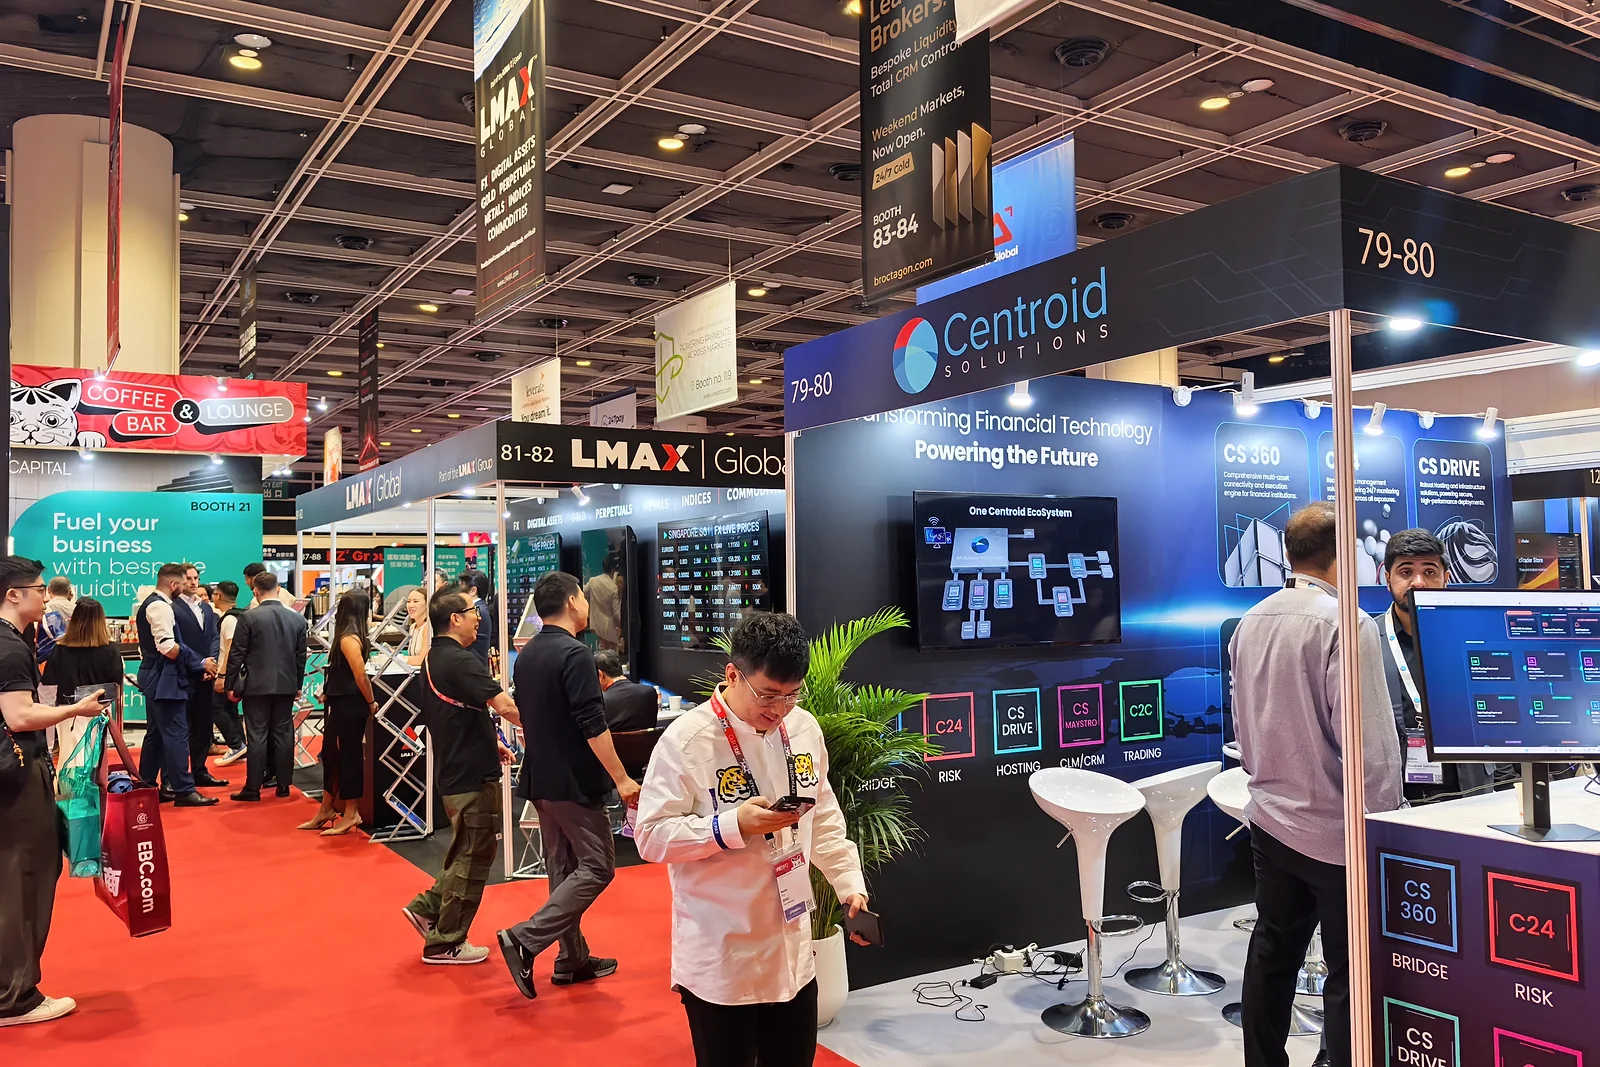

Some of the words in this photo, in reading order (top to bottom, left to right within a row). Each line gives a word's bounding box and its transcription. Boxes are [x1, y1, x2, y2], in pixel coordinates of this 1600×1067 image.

[870, 0, 947, 53] Brokers.
[870, 47, 912, 79] Bespoke
[914, 19, 957, 54] Liquidity
[870, 74, 893, 98] Total
[895, 60, 919, 83] CRM
[481, 55, 535, 145] LMAX
[871, 107, 918, 142] Weekend
[920, 85, 965, 117] Markets,
[872, 141, 895, 162] Now
[895, 127, 926, 149] Open.
[491, 155, 513, 183] DIGITAL
[513, 135, 536, 164] ASSETS
[875, 167, 893, 184] 24/7
[893, 157, 910, 176] Gold
[480, 189, 497, 210] GOLD
[499, 156, 536, 196] PERPETUALS
[484, 200, 505, 227] METALS
[508, 178, 533, 208] INDICES
[487, 203, 528, 242] COMMODITIES
[873, 204, 902, 227] BOOTH
[872, 212, 919, 250] 83-84
[1359, 227, 1435, 278] 79-80
[873, 256, 933, 287] broctagon.com
[944, 266, 1108, 356] Centroid
[944, 323, 1109, 378] SOLUTIONS
[695, 375, 713, 390] Booth
[791, 370, 833, 404] 79-80
[87, 385, 167, 409] COFFEE
[179, 404, 194, 420] &
[206, 402, 285, 420] LOUNGE
[530, 408, 546, 421] dream
[126, 416, 167, 432] BAR
[975, 409, 1056, 435] Financial
[1060, 416, 1153, 445] Technology
[501, 444, 554, 463] 81-82
[571, 438, 690, 472] LMAX
[915, 439, 1005, 469] Powering
[1007, 444, 1039, 465] the
[1040, 448, 1099, 467] Future
[1223, 443, 1247, 464] CS
[1250, 444, 1280, 466] 360
[9, 459, 72, 476] CAPITAL
[1223, 471, 1262, 480] Comprehensive
[1418, 456, 1438, 475] CS
[1440, 458, 1481, 477] DRIVE
[346, 477, 373, 511] LMAX
[377, 467, 402, 503] Global
[190, 501, 236, 512] BOOTH
[238, 502, 251, 512] 21
[513, 522, 520, 531] FX
[527, 517, 546, 530] DIGITAL
[546, 515, 563, 528] ASSETS
[595, 504, 633, 519] PERPETUALS
[681, 491, 712, 507] INDICES
[969, 506, 988, 516] One
[988, 506, 1026, 517] Centroid
[1026, 507, 1073, 519] EcoSystem
[53, 512, 102, 531] Fuel
[108, 516, 159, 535] your
[737, 521, 760, 533] PRICES
[53, 535, 153, 554] business
[53, 557, 102, 575] with
[1007, 706, 1025, 720] CS
[1072, 702, 1090, 716] CS
[1129, 703, 1153, 717] C2C
[935, 718, 963, 735] C24
[1001, 721, 1034, 736] DRIVE
[1065, 718, 1098, 729] MAYSTRO
[1059, 753, 1106, 769] CLM/CRM
[1123, 747, 1162, 762] TRADING
[938, 769, 962, 783] RISK
[996, 760, 1041, 777] HOSTING
[857, 776, 896, 792] RIDGE
[137, 841, 155, 914] EBC.com
[1404, 879, 1431, 900] CS
[1400, 901, 1437, 925] 360
[1509, 913, 1555, 939] C24
[1392, 952, 1449, 980] BRIDGE
[1515, 982, 1554, 1008] RISK
[1406, 1027, 1434, 1050] CS
[1398, 1045, 1447, 1067] DRIVE
